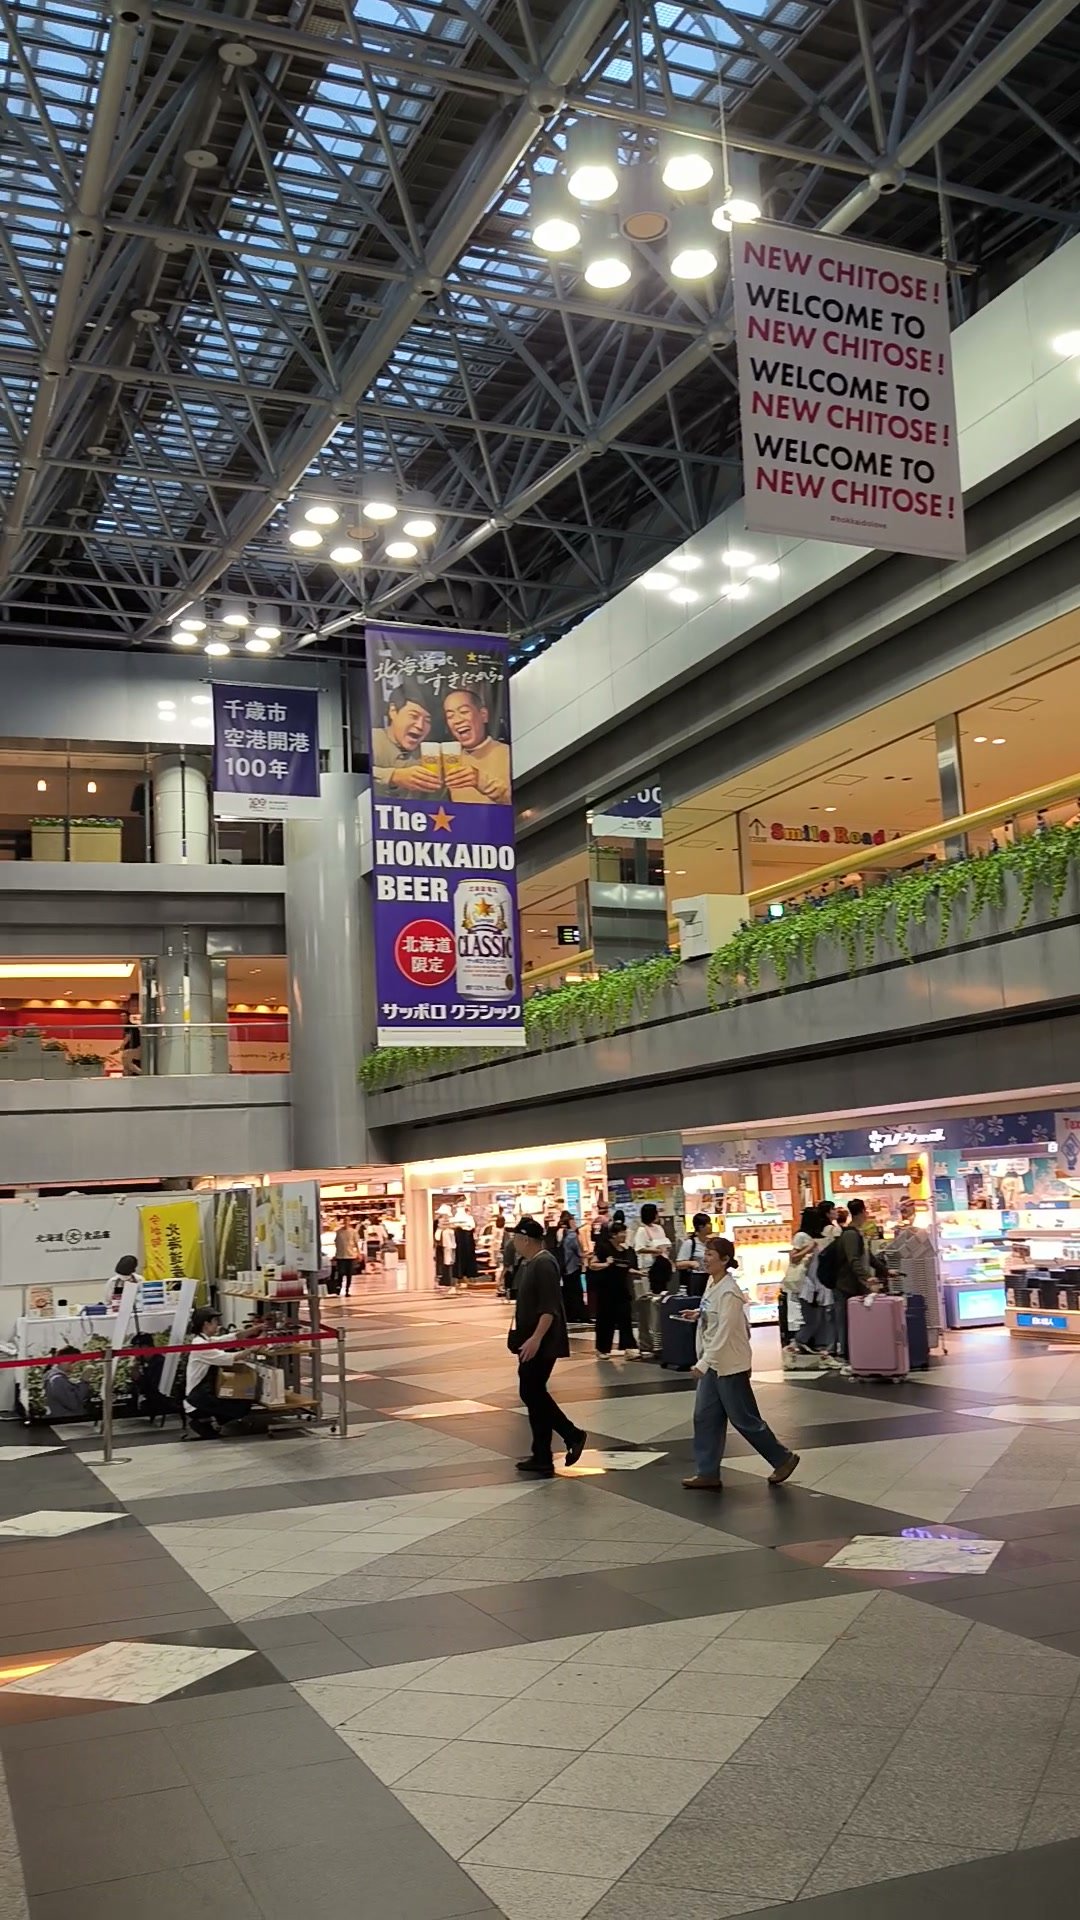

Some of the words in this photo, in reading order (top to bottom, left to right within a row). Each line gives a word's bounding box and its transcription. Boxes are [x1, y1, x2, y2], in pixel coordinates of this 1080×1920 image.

[743, 241, 812, 275] NEW
[746, 283, 883, 332] WELCOME
[892, 313, 925, 339] TO
[747, 316, 817, 349] NEW
[750, 358, 887, 404] WELCOME
[896, 384, 930, 412] TO
[752, 391, 821, 424] NEW
[754, 433, 892, 477] WELCOME
[900, 457, 935, 484] TO
[756, 466, 825, 499] NEW
[223, 699, 288, 722] 千歳市
[224, 728, 310, 753] 空港開港
[224, 757, 289, 780] 100年
[374, 804, 428, 832] The
[771, 823, 830, 843] Smile
[833, 826, 885, 846] Road
[375, 840, 515, 871] HOKKAIDO
[376, 875, 449, 903] BEER
[402, 935, 453, 953] 北海道
[458, 935, 512, 958] CLASSIC
[411, 956, 446, 974] 限定
[381, 1002, 447, 1020] サッポロ
[450, 1004, 521, 1020] クラシック
